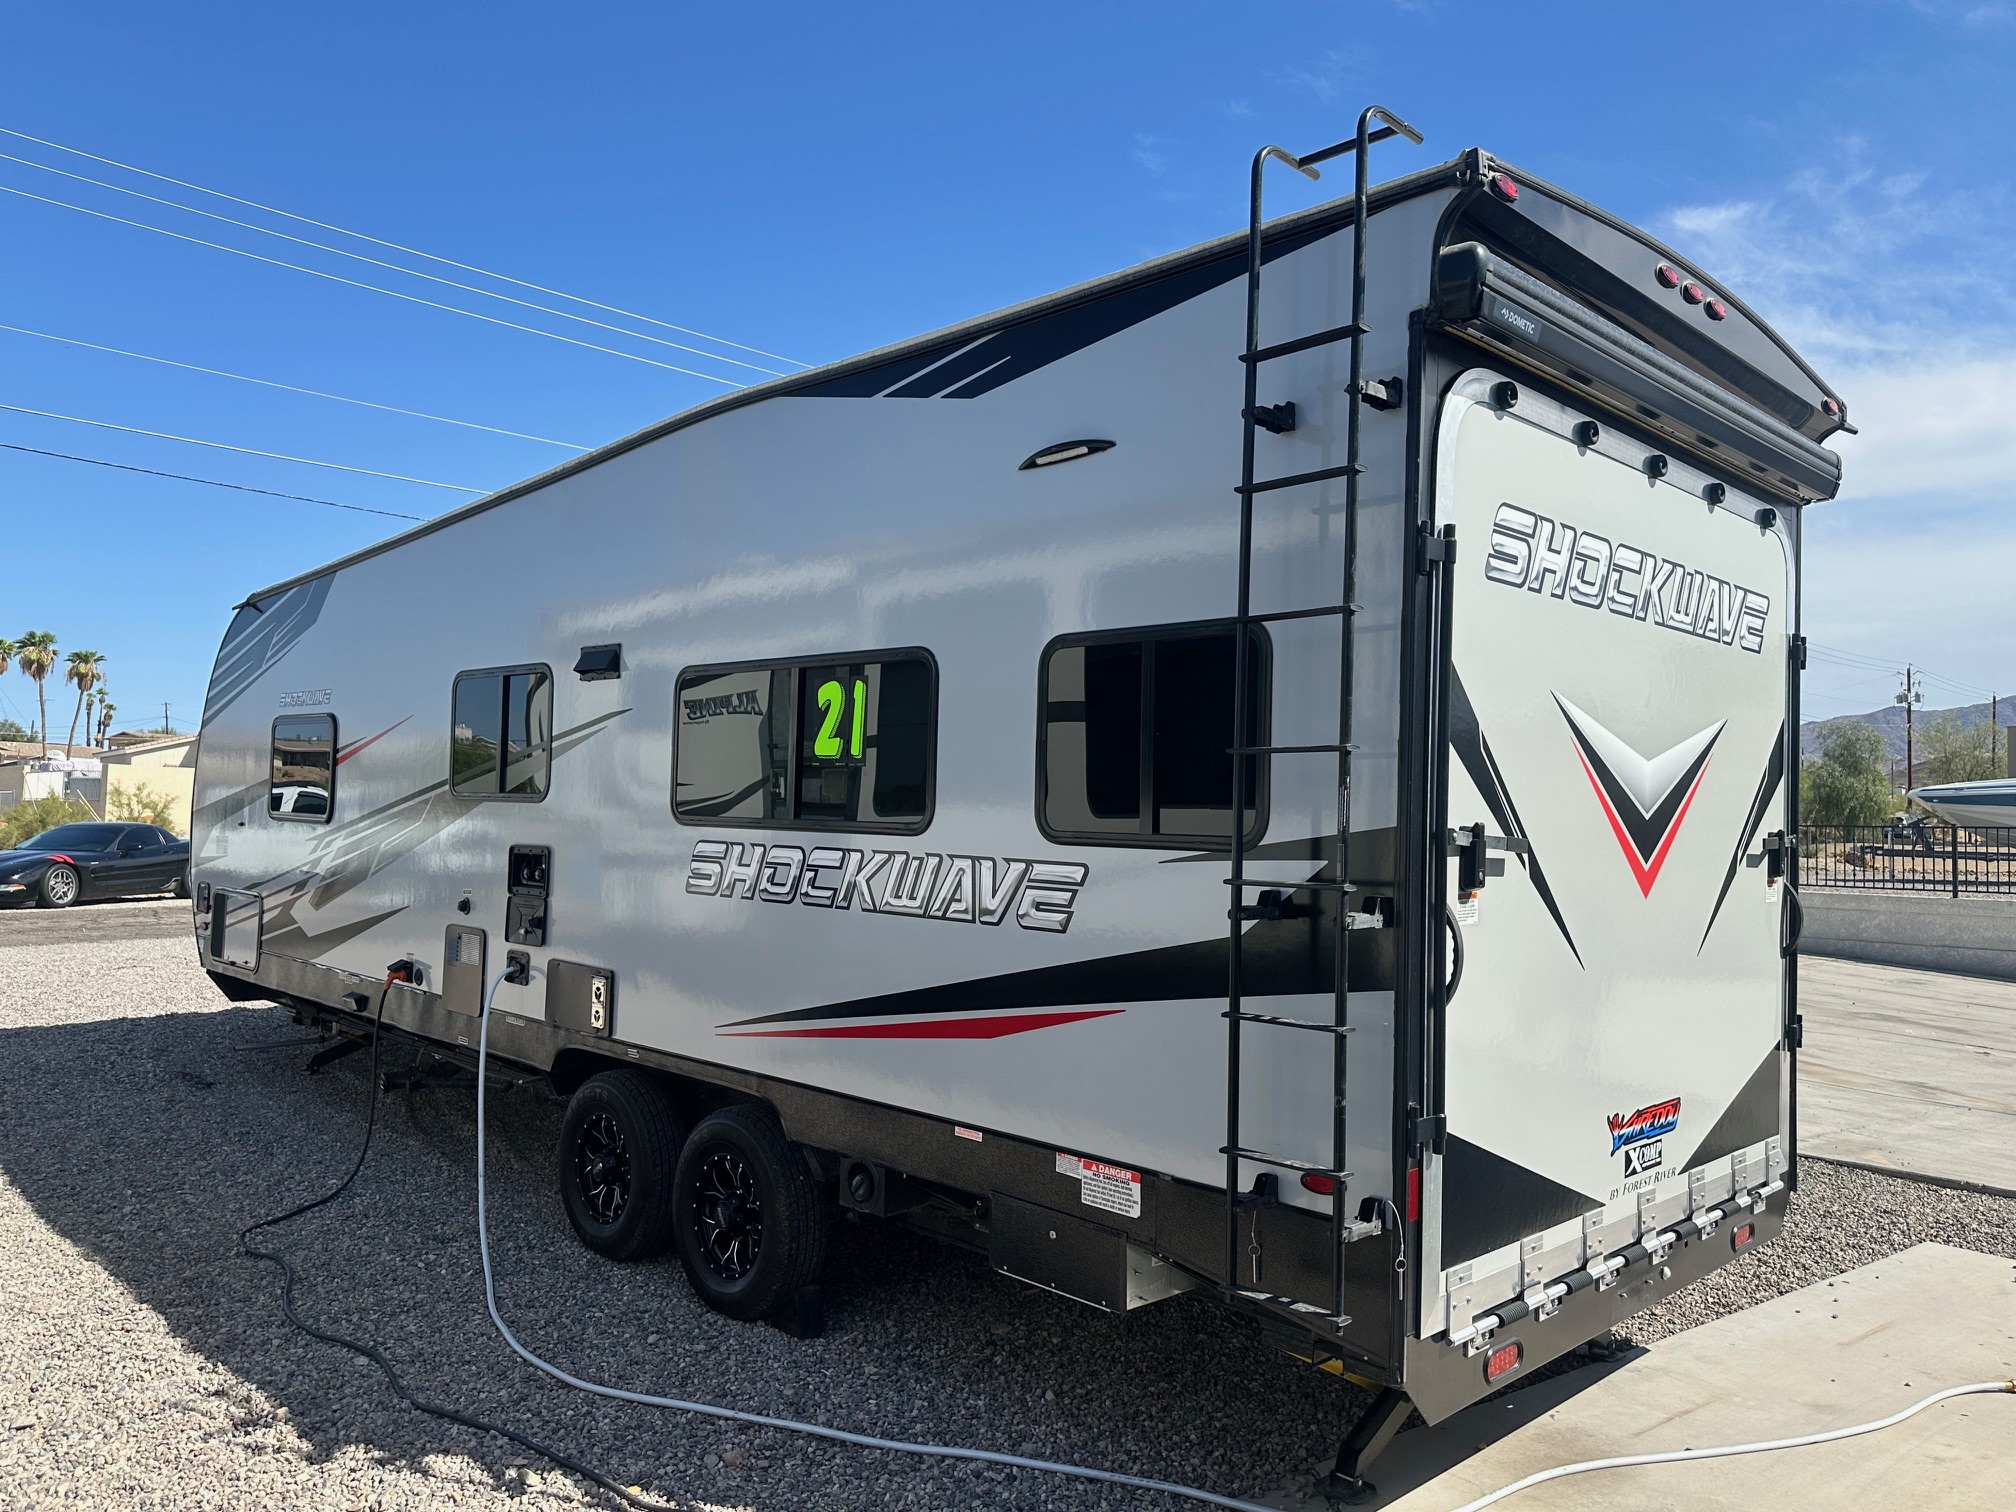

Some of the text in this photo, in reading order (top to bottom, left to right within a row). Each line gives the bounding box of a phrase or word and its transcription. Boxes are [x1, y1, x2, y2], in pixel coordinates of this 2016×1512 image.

[1508, 311, 1535, 335] DOMETIC
[1484, 501, 1770, 654] SHOCKWAVE
[279, 688, 332, 708] SHOCKWAVE
[814, 680, 867, 759] 21
[685, 840, 1090, 934] SHOCKWAVE
[1098, 1164, 1132, 1181] DANGER
[1102, 1174, 1130, 1187] SMOKING
[1609, 1166, 1677, 1201] BY FOREST RIVER
